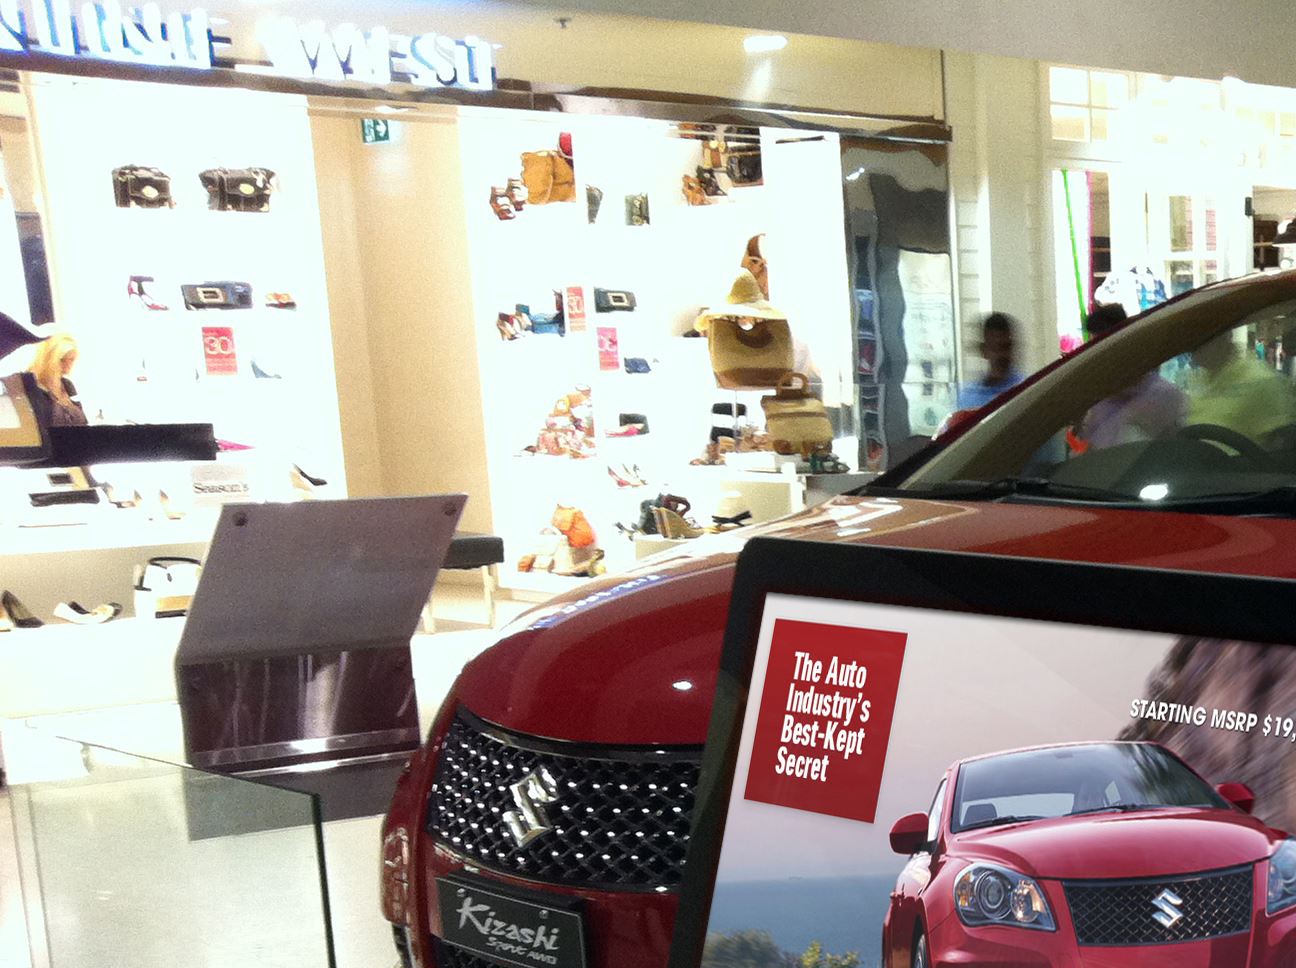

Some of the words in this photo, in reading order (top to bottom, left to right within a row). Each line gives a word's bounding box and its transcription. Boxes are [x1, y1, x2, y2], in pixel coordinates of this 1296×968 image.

[793, 651, 823, 683] The
[825, 656, 867, 688] Auto
[786, 683, 871, 726] Industry's
[1129, 698, 1207, 725] STARTING
[1210, 709, 1258, 732] MSRP
[780, 714, 866, 759] Best-Kept
[775, 746, 829, 782] Secret
[456, 897, 560, 951] Kizashi
